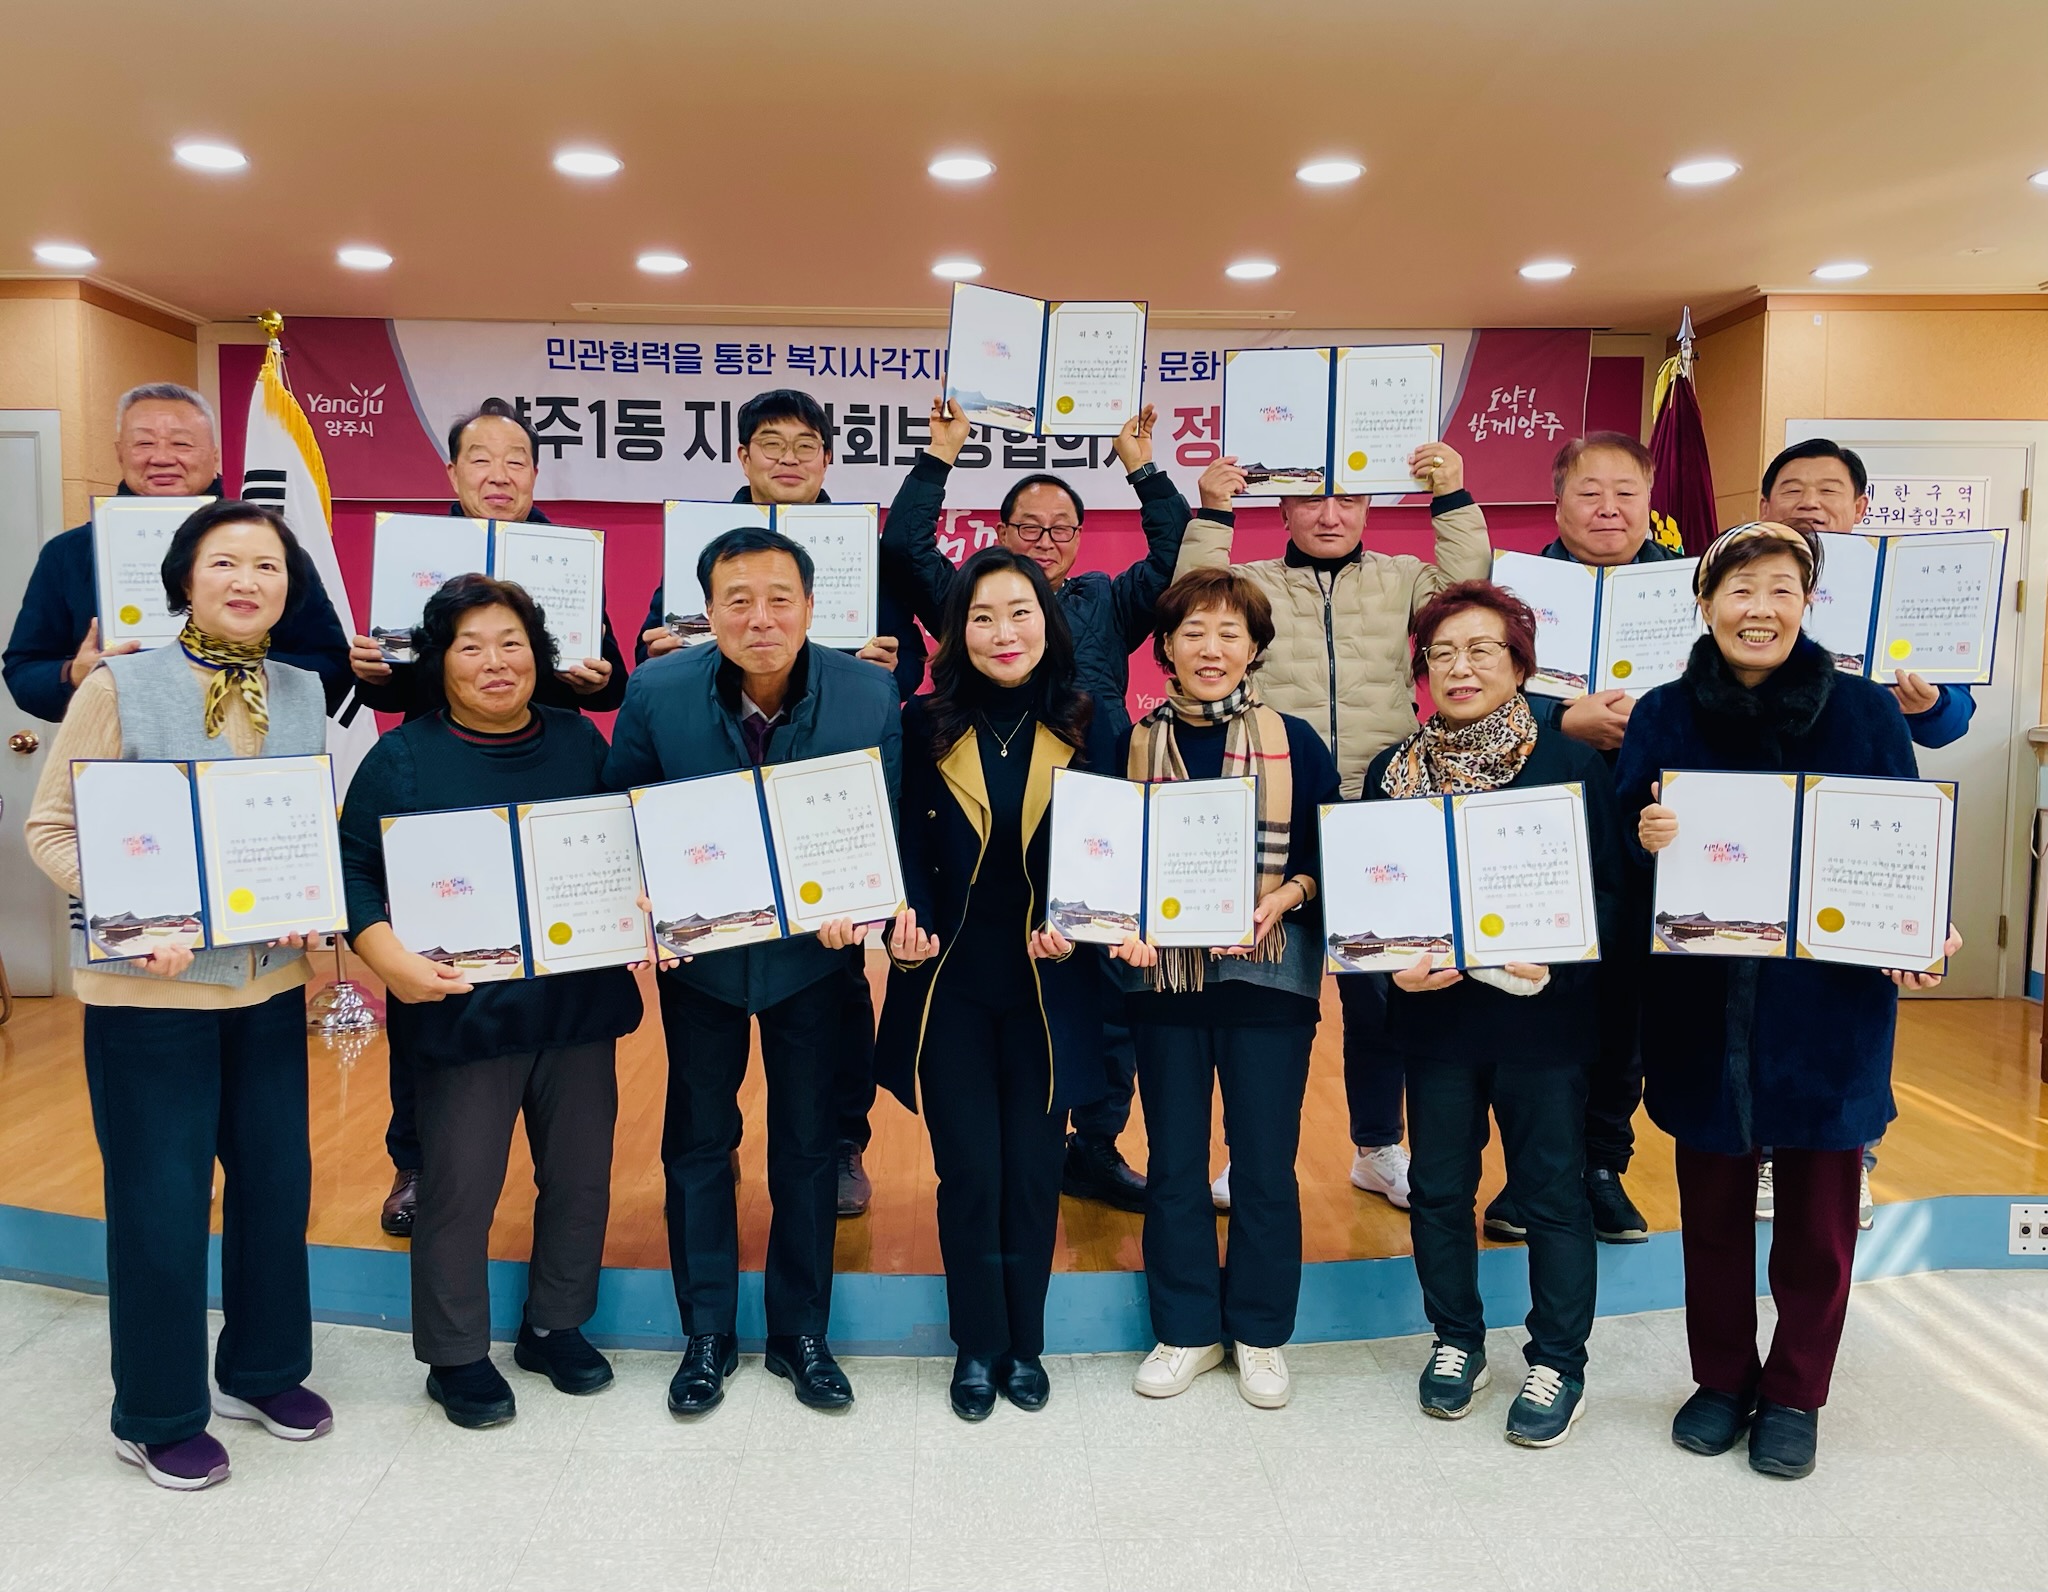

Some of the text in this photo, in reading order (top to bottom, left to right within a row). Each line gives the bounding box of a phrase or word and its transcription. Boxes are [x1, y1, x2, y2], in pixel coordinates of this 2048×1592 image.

[546, 338, 703, 374] 민관협력을
[714, 343, 776, 375] 통한
[787, 344, 948, 380] 복지사각지
[1487, 385, 1536, 413] 도약!
[324, 420, 374, 437] 양주시
